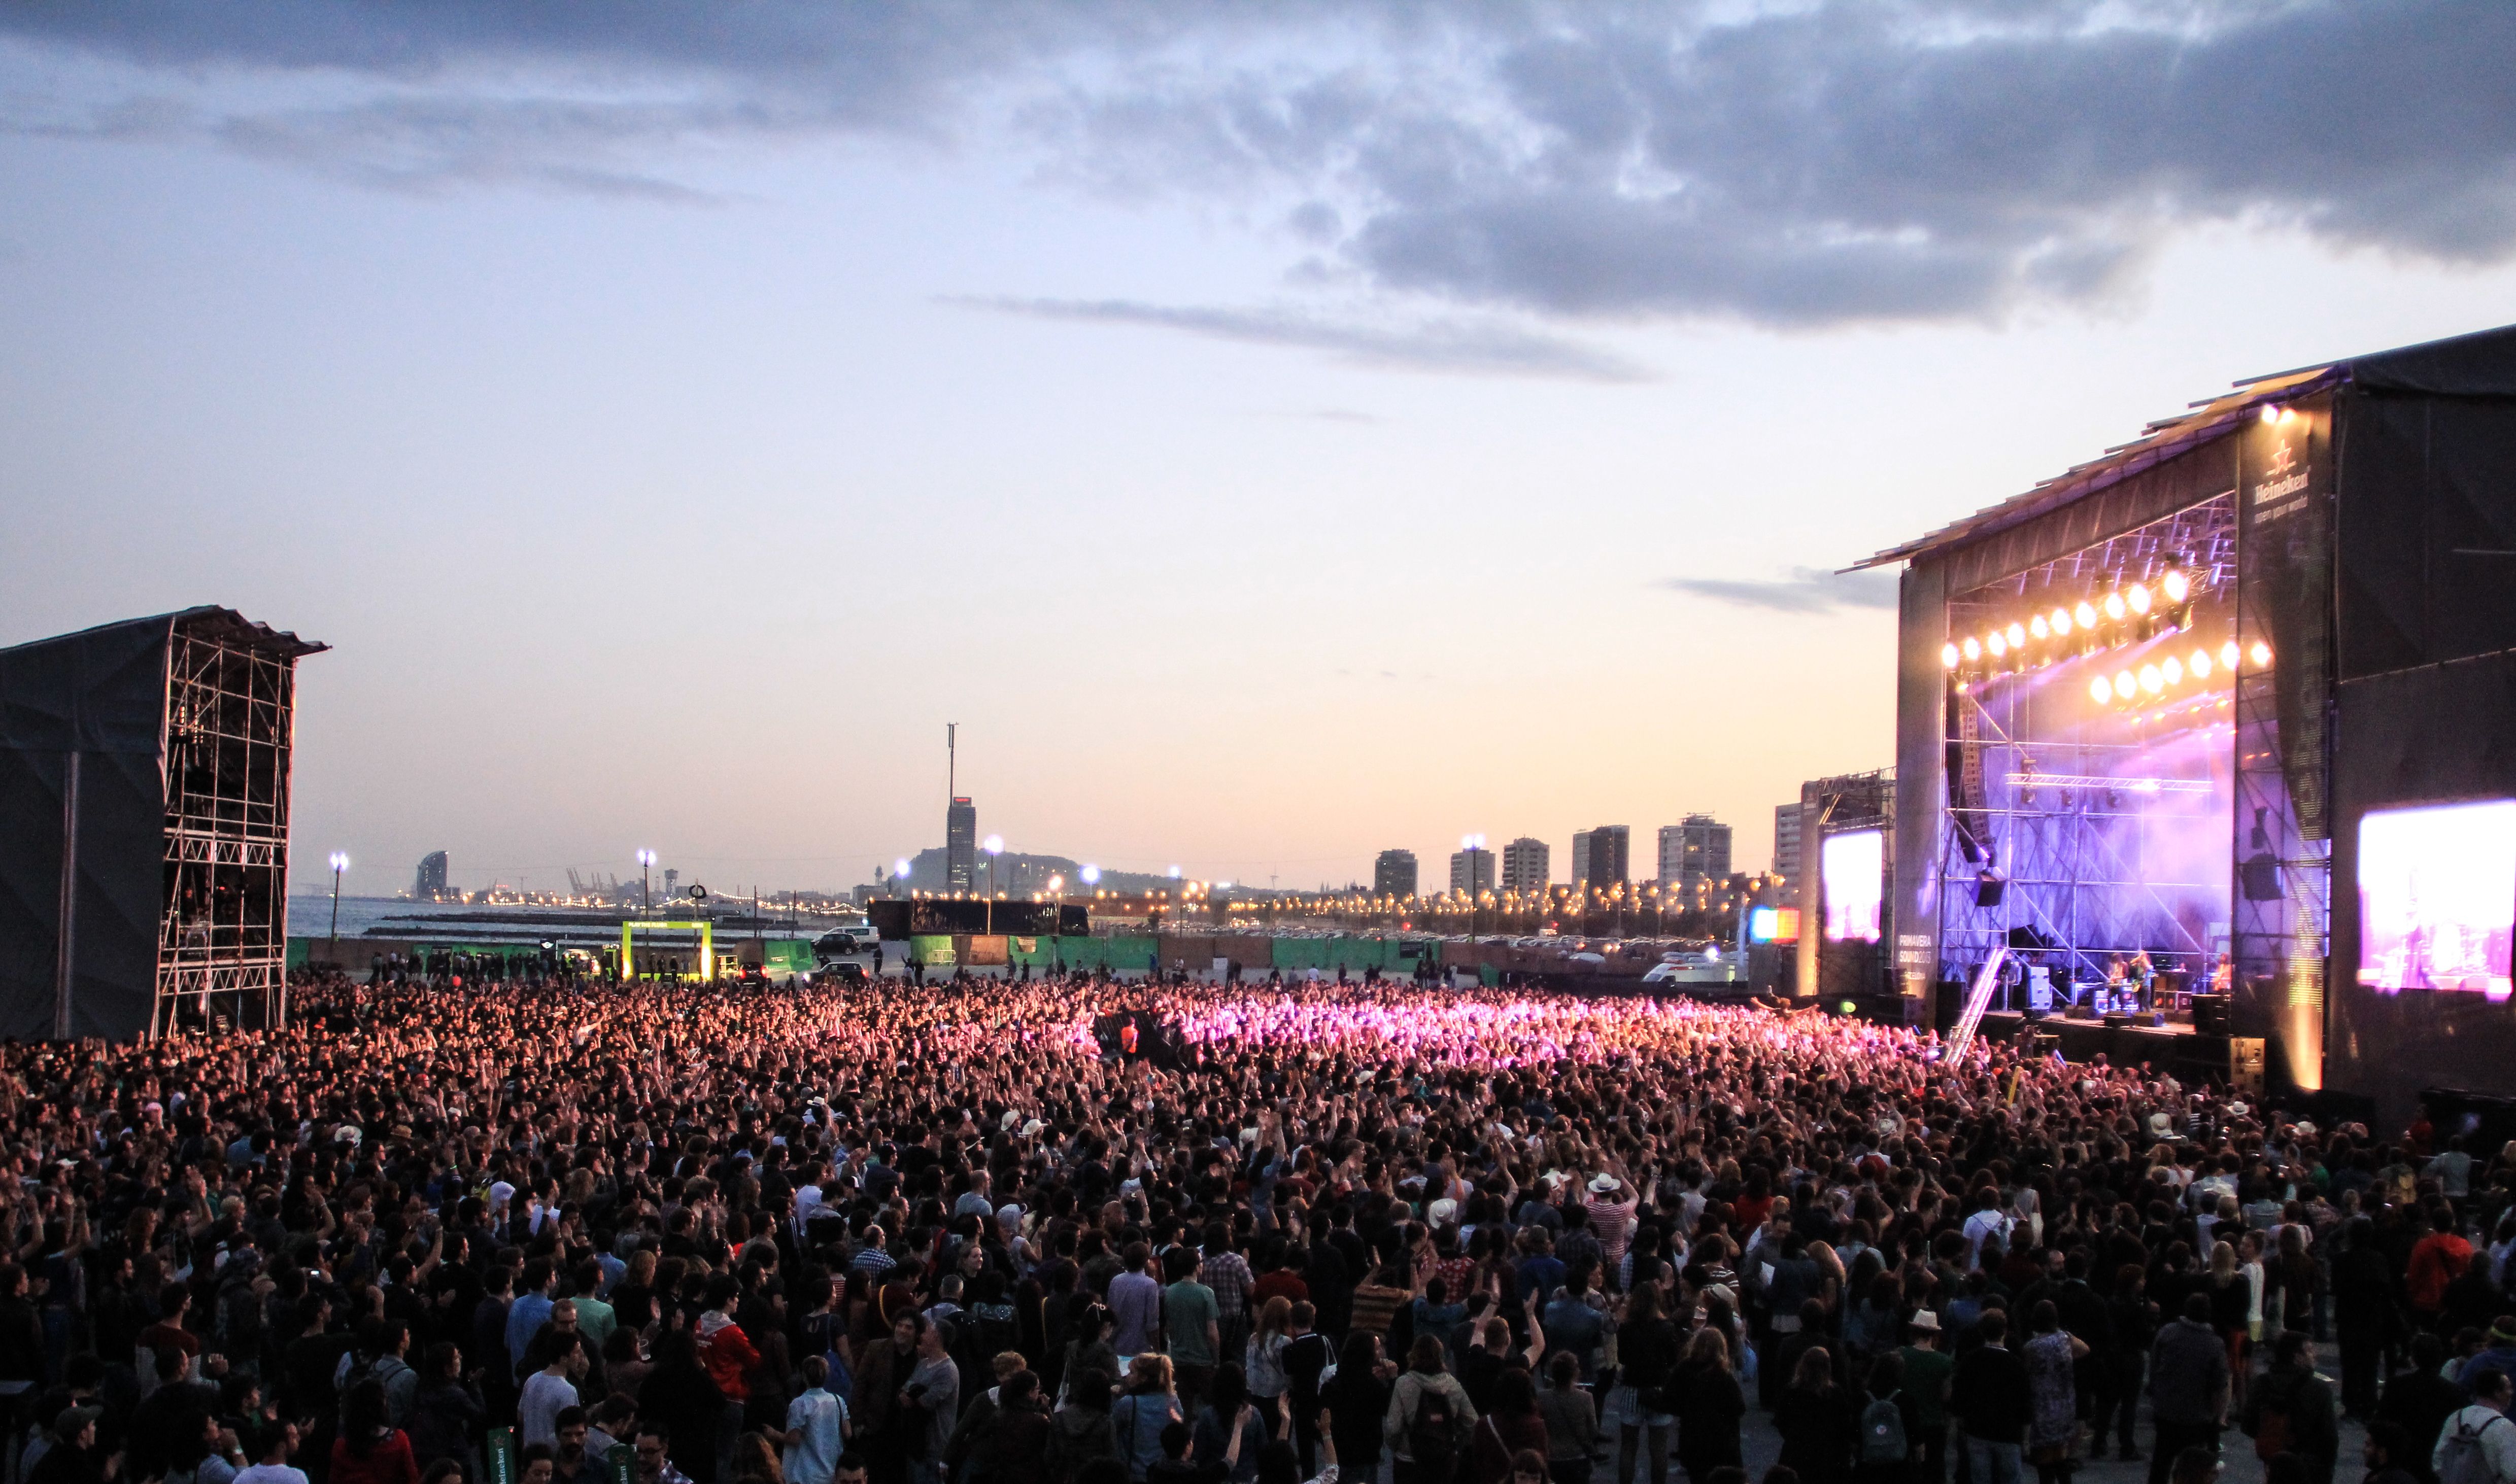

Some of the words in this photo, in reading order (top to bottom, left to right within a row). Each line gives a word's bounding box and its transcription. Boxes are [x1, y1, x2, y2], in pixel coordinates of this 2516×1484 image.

[2254, 472, 2308, 505] Heineken
[1899, 935, 1931, 947] PRIMAVERA
[497, 1447, 506, 1484] eineken
